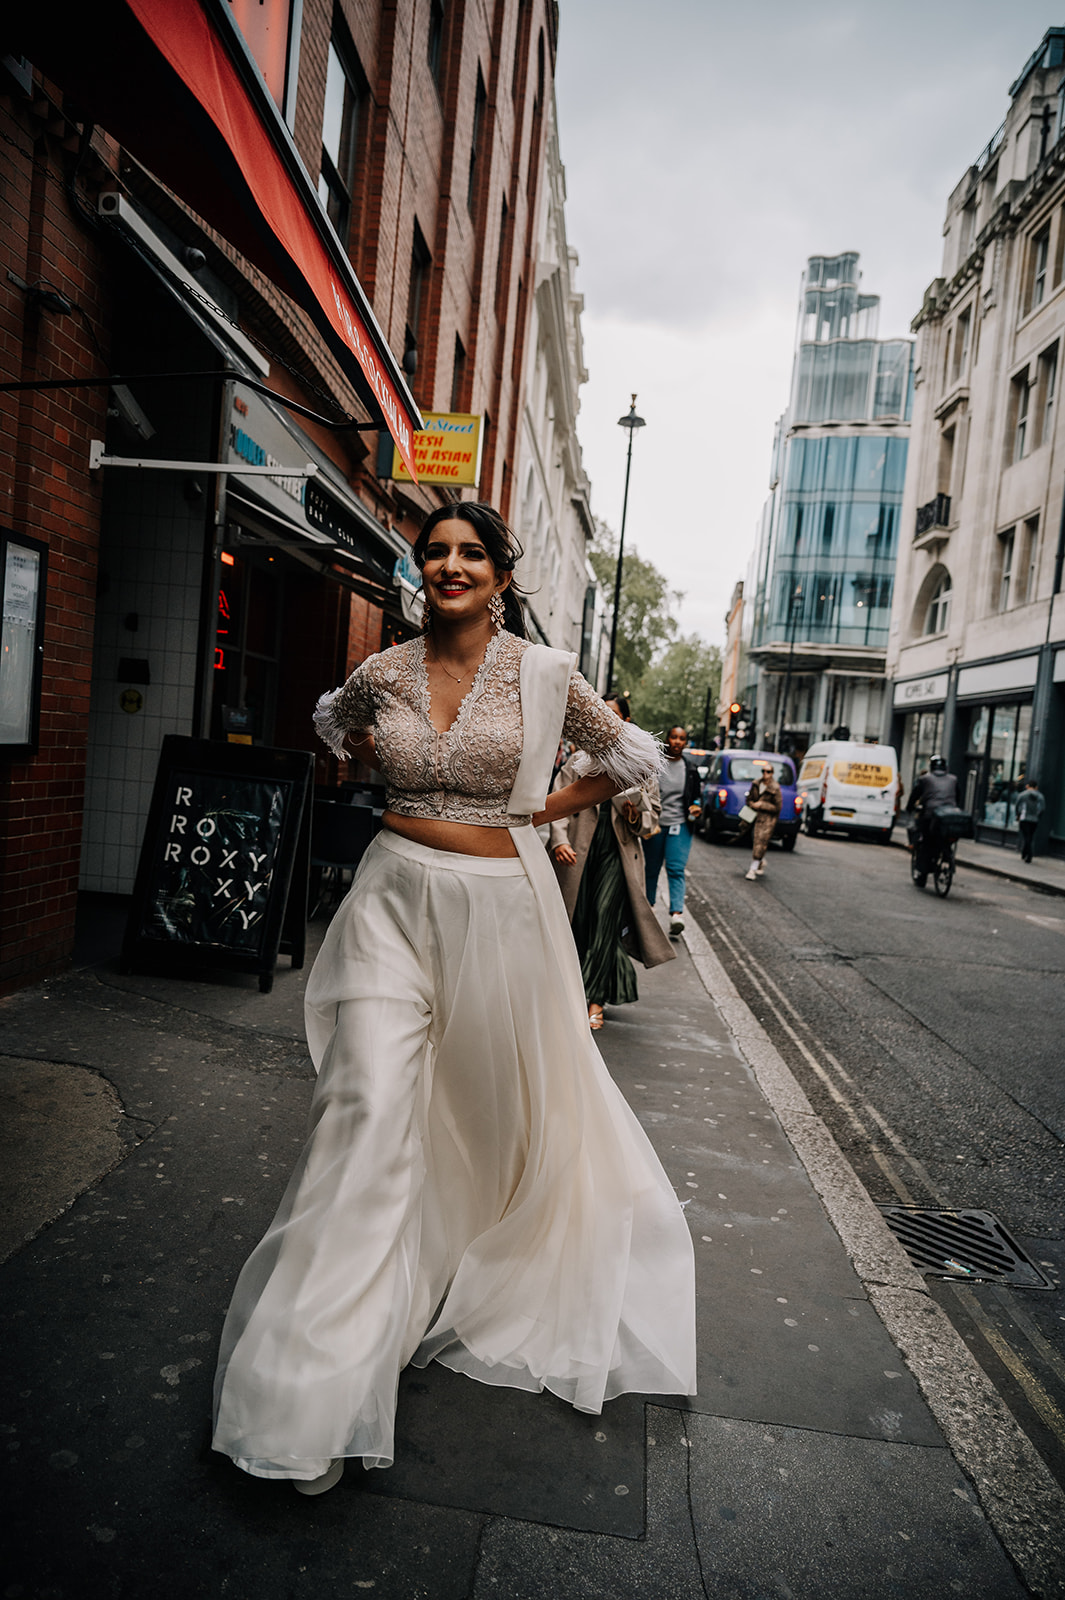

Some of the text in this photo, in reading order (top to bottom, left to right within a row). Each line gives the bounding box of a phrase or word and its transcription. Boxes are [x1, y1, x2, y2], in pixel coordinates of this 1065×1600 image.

[435, 418, 475, 434] Street
[413, 434, 444, 447] RESH
[431, 450, 472, 464] ASIAN
[399, 461, 459, 477] COKING
[175, 786, 193, 807] R
[164, 842, 268, 873] ROXY
[239, 909, 258, 931] Y
